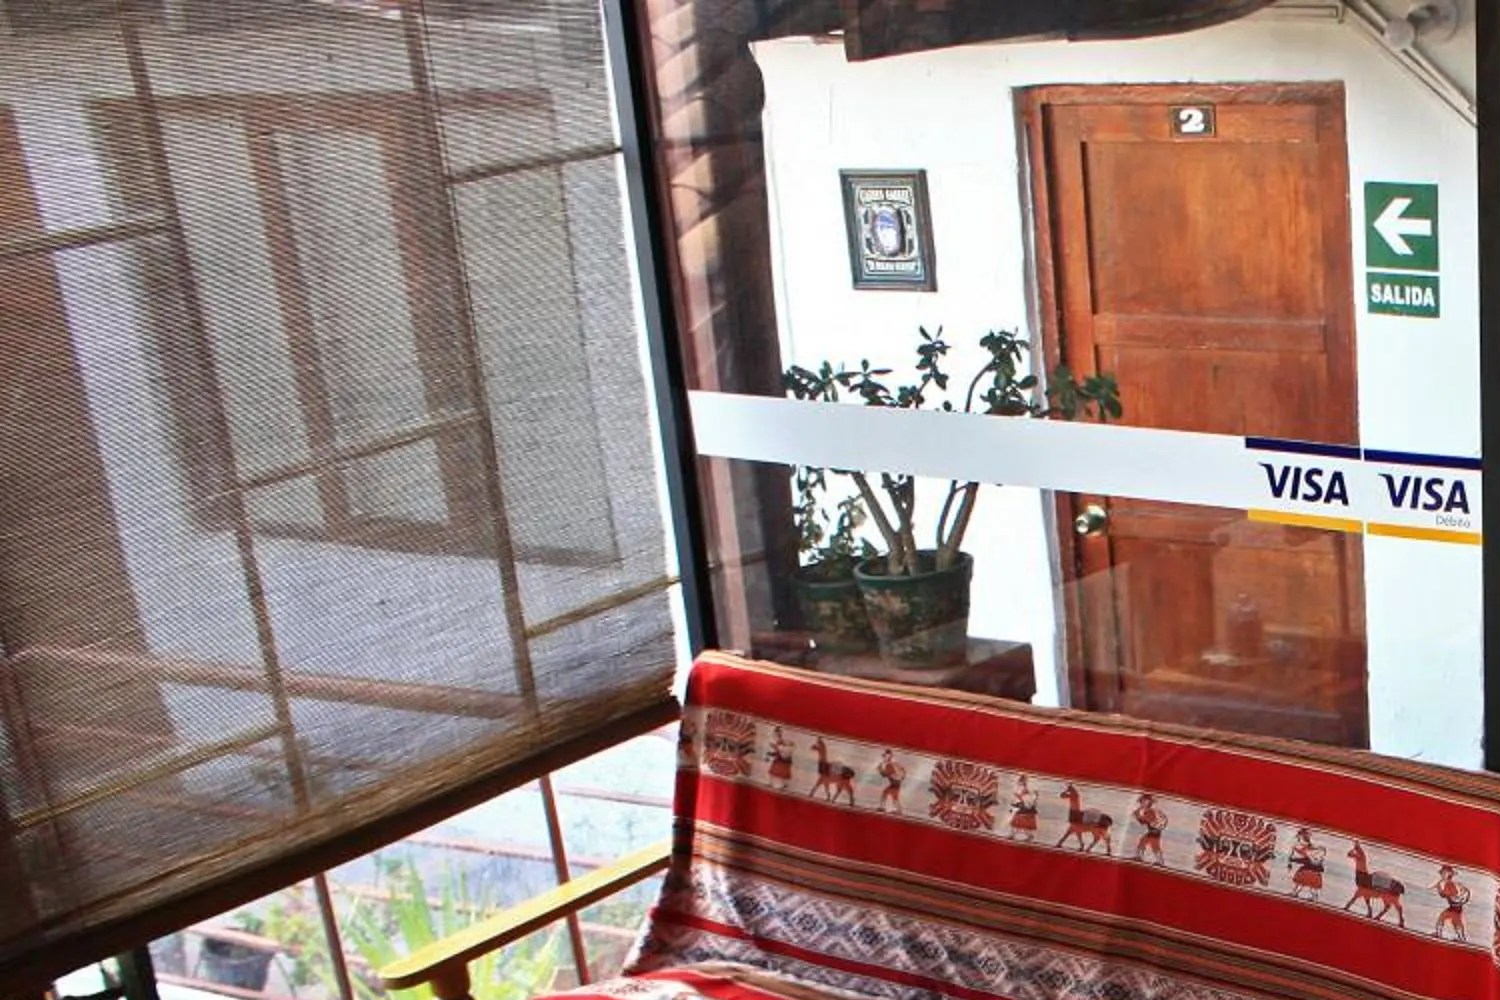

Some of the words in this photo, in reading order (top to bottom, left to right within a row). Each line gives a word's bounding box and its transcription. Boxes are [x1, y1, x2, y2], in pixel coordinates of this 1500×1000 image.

[1179, 109, 1205, 133] 2
[1371, 283, 1436, 307] SALIDA
[1258, 462, 1349, 506] VISA
[1378, 473, 1470, 514] VISA
